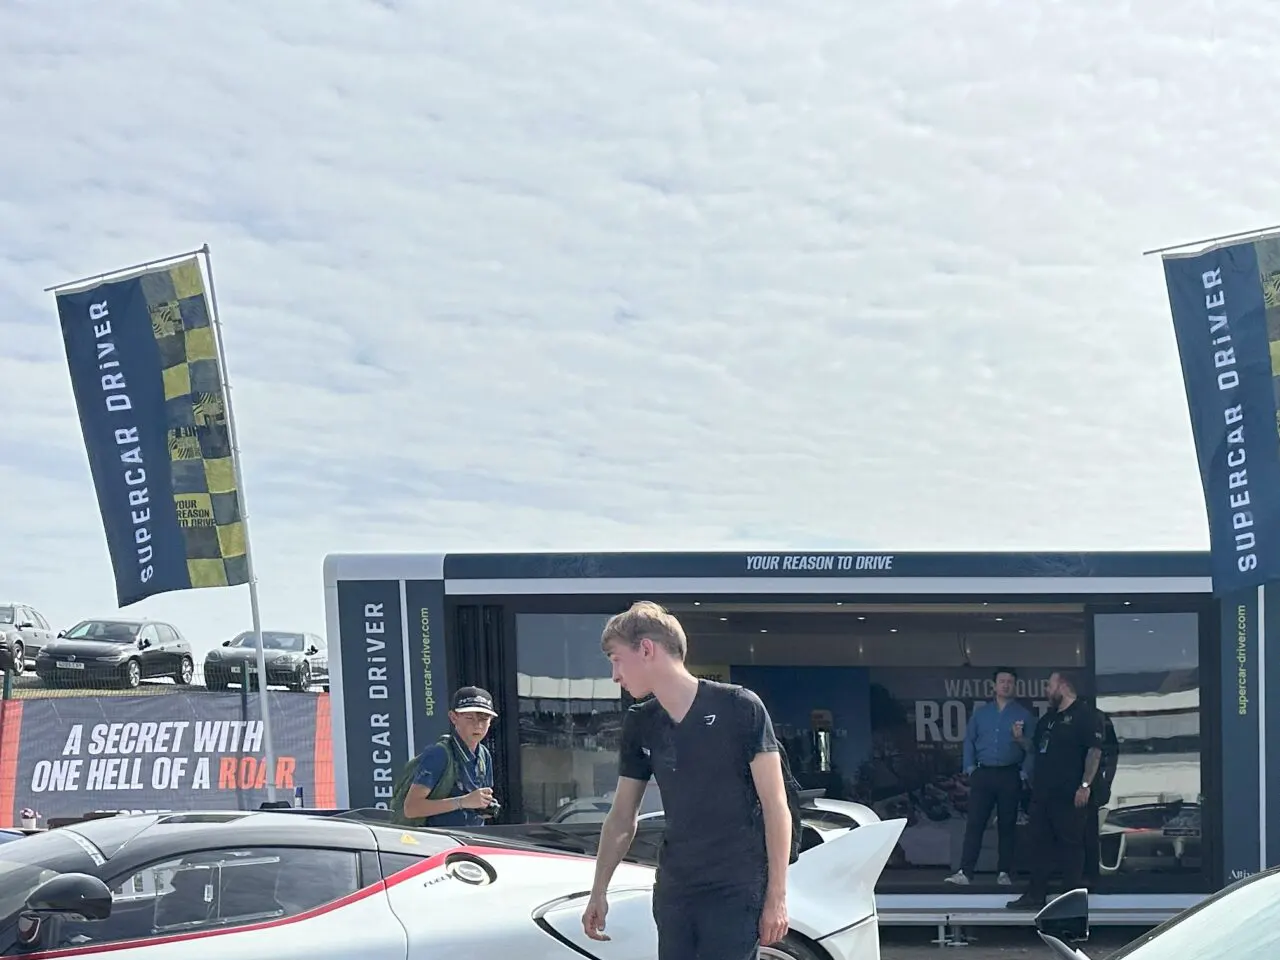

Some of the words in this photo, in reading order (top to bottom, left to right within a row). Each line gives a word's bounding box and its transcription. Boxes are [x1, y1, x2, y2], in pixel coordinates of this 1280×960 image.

[114, 425, 153, 583] SUPERCAR
[177, 508, 210, 519] REASON
[1224, 403, 1257, 573] SUPERCAR
[746, 555, 780, 570] YOUR
[783, 555, 834, 570] REASON
[837, 555, 853, 570] TO
[855, 555, 894, 570] DRIVE
[420, 607, 434, 717] supercar-driver.com
[944, 679, 996, 698] WATC
[1236, 604, 1248, 716] supercar-driver.com
[62, 723, 84, 756] A
[88, 721, 190, 755] SECRET
[193, 720, 264, 753] WITH
[371, 712, 394, 811] PERCAR
[31, 759, 84, 792] ONE
[86, 758, 143, 791] HELL
[151, 757, 189, 790] OF
[192, 757, 211, 790] A
